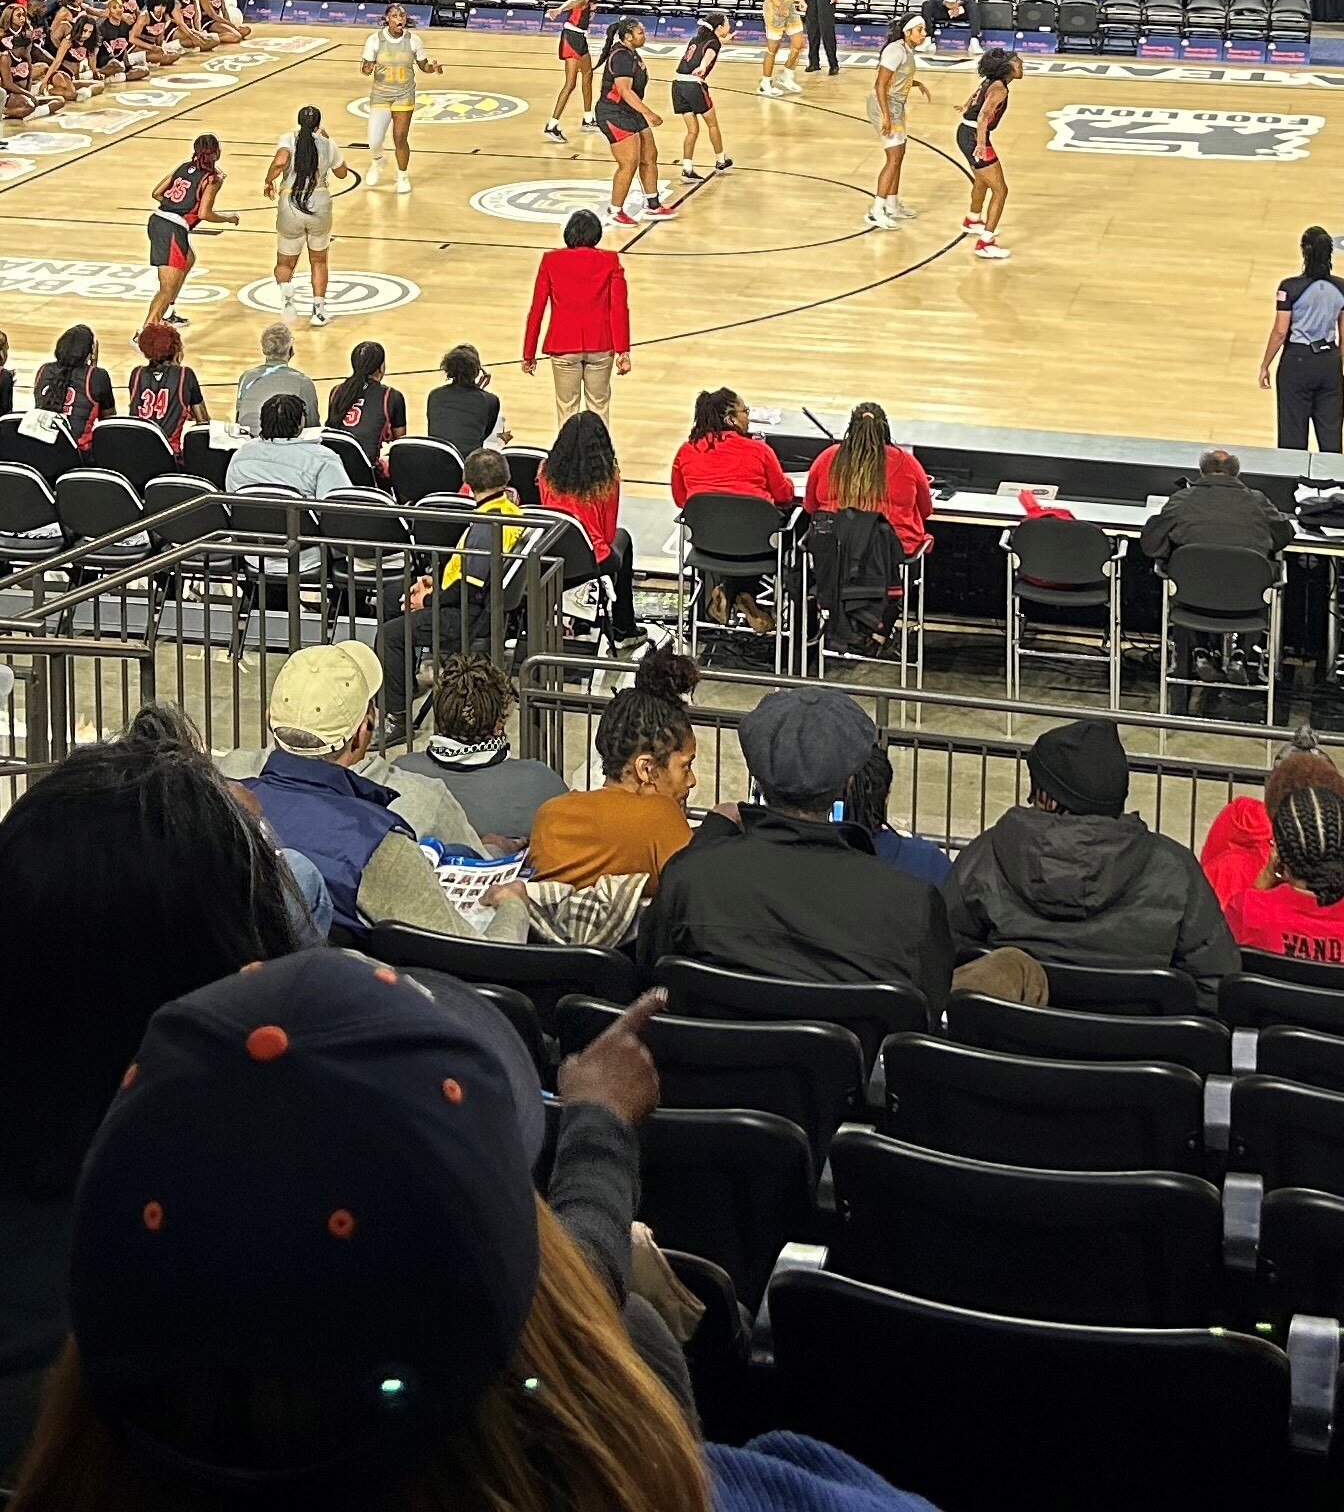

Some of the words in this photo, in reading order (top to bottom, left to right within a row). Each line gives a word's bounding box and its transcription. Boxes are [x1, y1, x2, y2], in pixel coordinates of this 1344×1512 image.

[1075, 106, 1182, 120] LION
[1195, 112, 1312, 126] FOOD
[137, 388, 170, 420] 34
